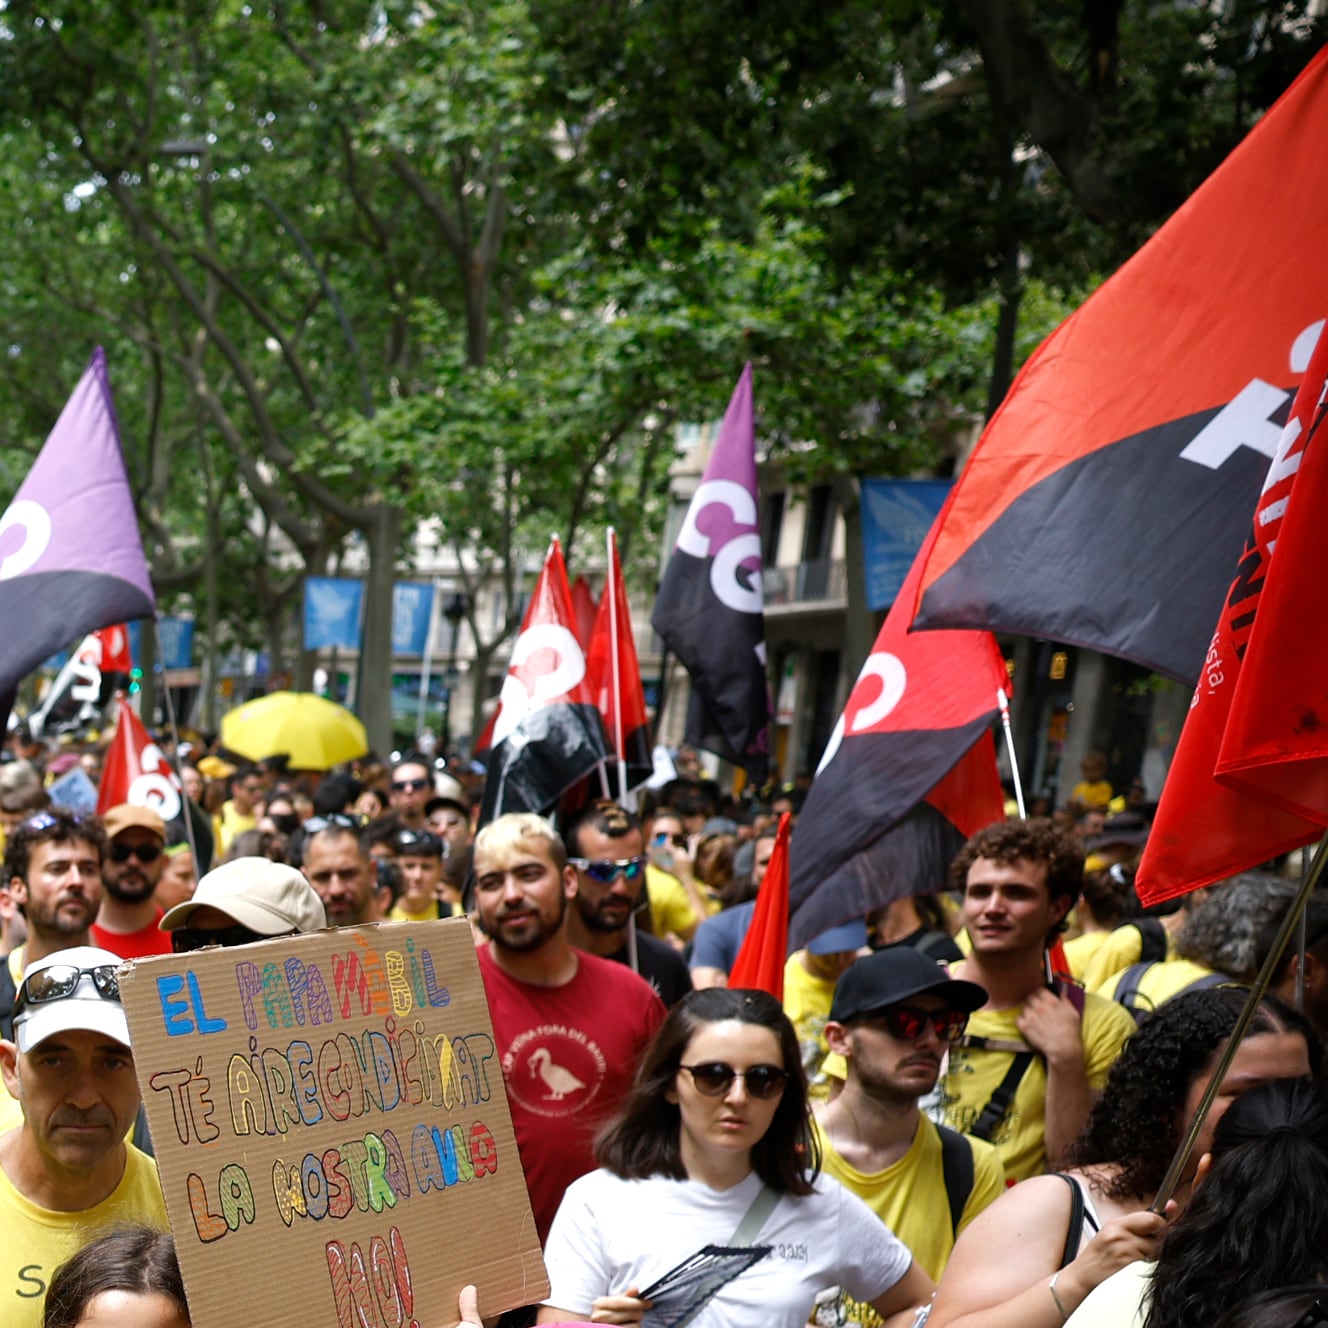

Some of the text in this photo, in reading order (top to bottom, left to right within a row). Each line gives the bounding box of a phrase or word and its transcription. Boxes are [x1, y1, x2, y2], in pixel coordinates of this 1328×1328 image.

[156, 969, 227, 1036] EL
[186, 1163, 256, 1244] LA
[271, 1128, 411, 1228] NOSTRA
